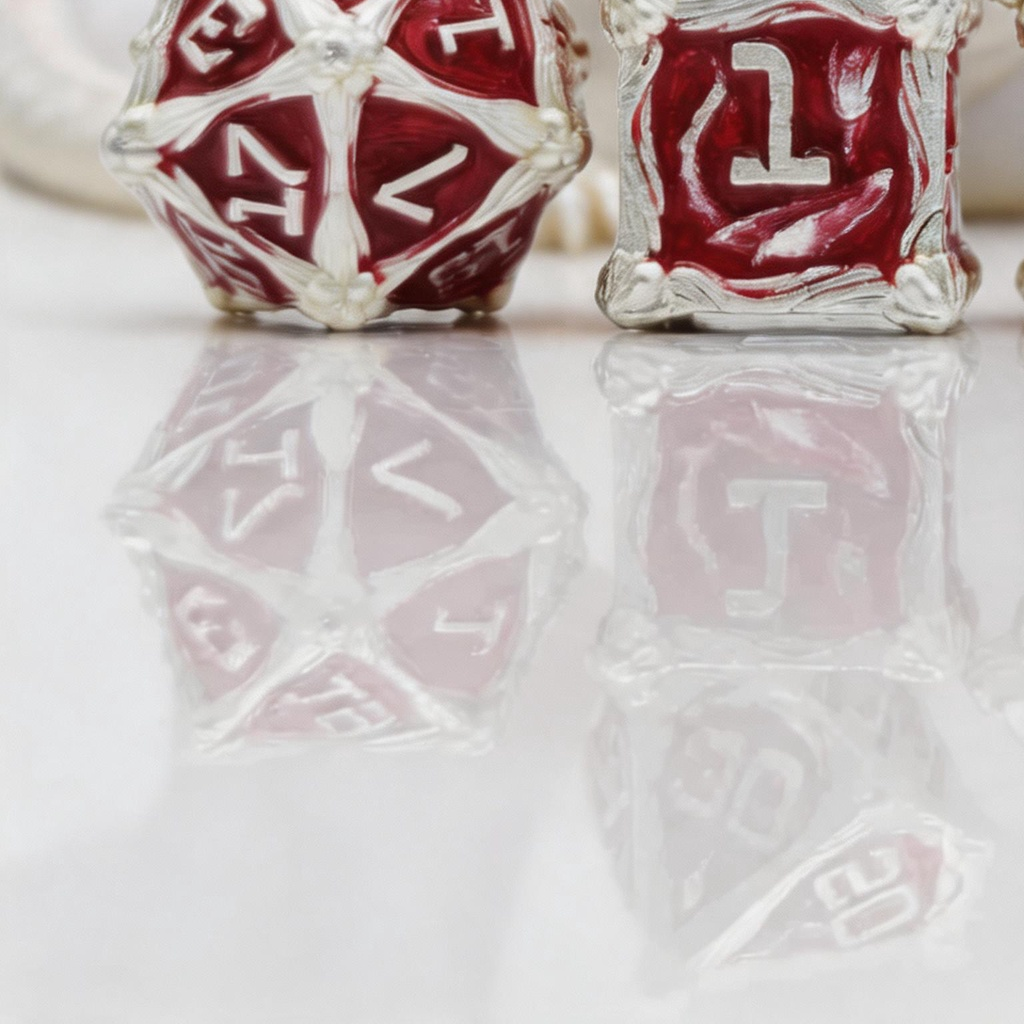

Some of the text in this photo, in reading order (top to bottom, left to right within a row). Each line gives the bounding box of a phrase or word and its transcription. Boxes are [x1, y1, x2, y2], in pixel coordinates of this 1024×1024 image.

[730, 41, 832, 186] 1
[224, 122, 309, 236] 17
[373, 143, 469, 225] 7
